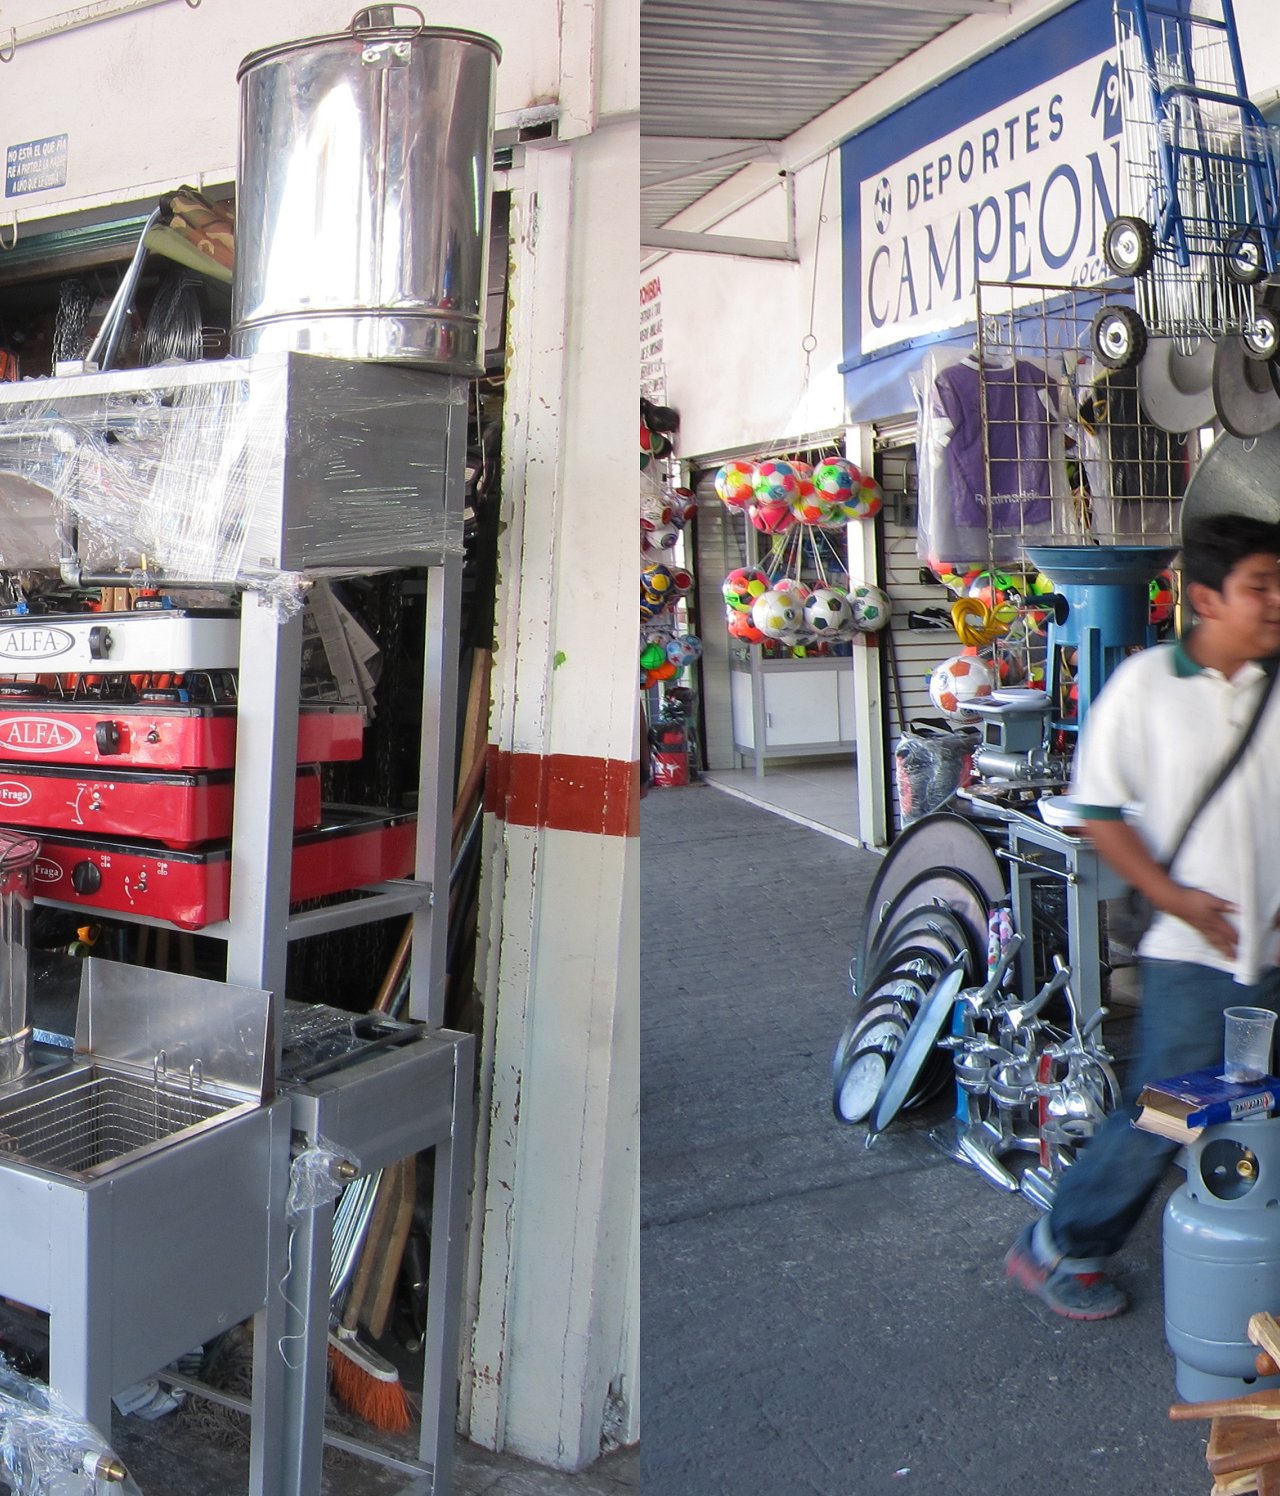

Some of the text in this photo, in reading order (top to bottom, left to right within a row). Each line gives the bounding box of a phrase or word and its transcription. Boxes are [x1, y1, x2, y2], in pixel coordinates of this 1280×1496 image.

[8, 151, 17, 163] NO
[18, 143, 33, 161] ESTÁ
[34, 144, 41, 157] EL
[43, 142, 55, 156] QUE
[906, 93, 1064, 212] DEPORTES
[4, 631, 59, 652] ALFA
[6, 722, 63, 745] ALFA
[2, 789, 28, 801] Fraga
[35, 865, 59, 877] Fraga
